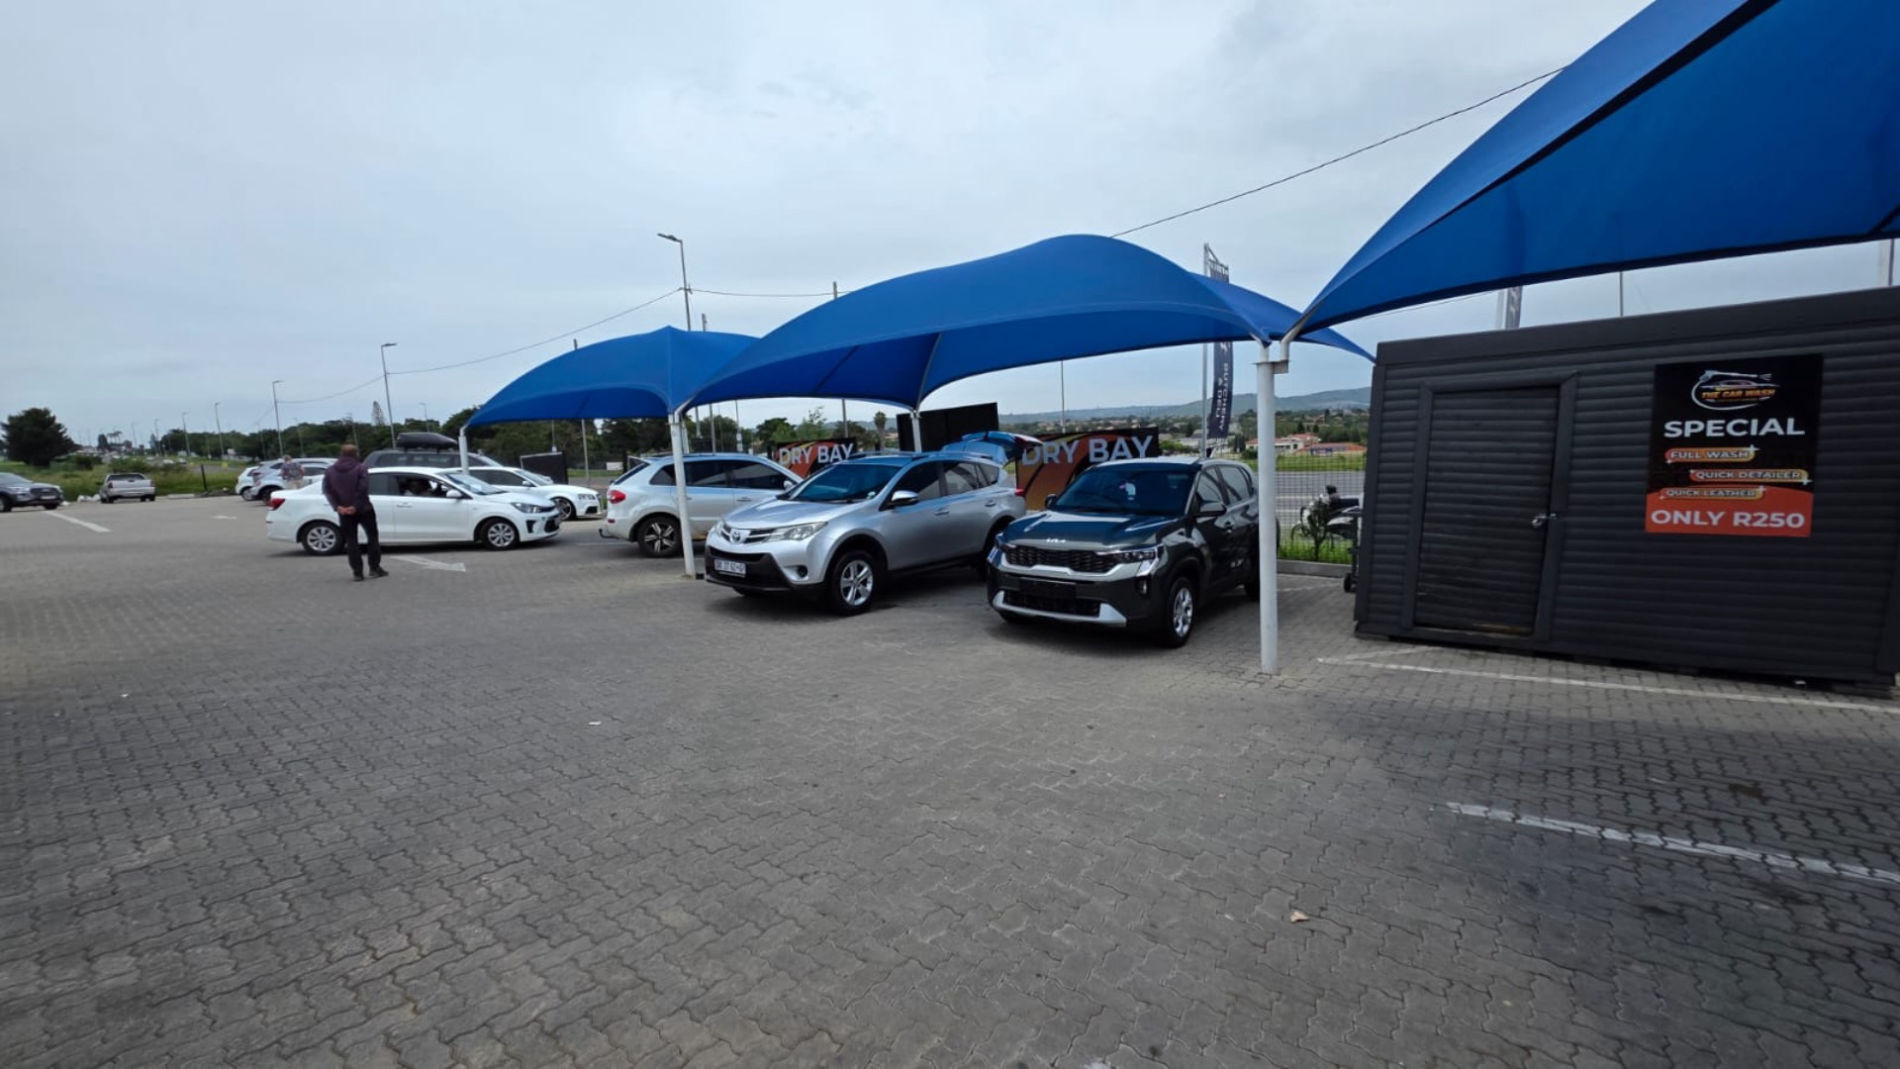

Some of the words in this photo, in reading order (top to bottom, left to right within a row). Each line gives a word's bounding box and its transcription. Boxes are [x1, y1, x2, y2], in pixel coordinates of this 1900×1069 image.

[1664, 417, 1806, 439] SPECIAL
[779, 446, 813, 465] DRY
[817, 443, 853, 463] BAY
[1022, 440, 1079, 466] DRY
[1088, 435, 1153, 463] BAY
[1670, 451, 1701, 459] FULL
[1706, 451, 1748, 459] WASH
[1695, 471, 1735, 479] QUICK
[1738, 471, 1800, 479] DETAILER
[1666, 489, 1700, 497] QUICK
[1651, 509, 1726, 526] ONLY
[1732, 511, 1806, 529] R250
